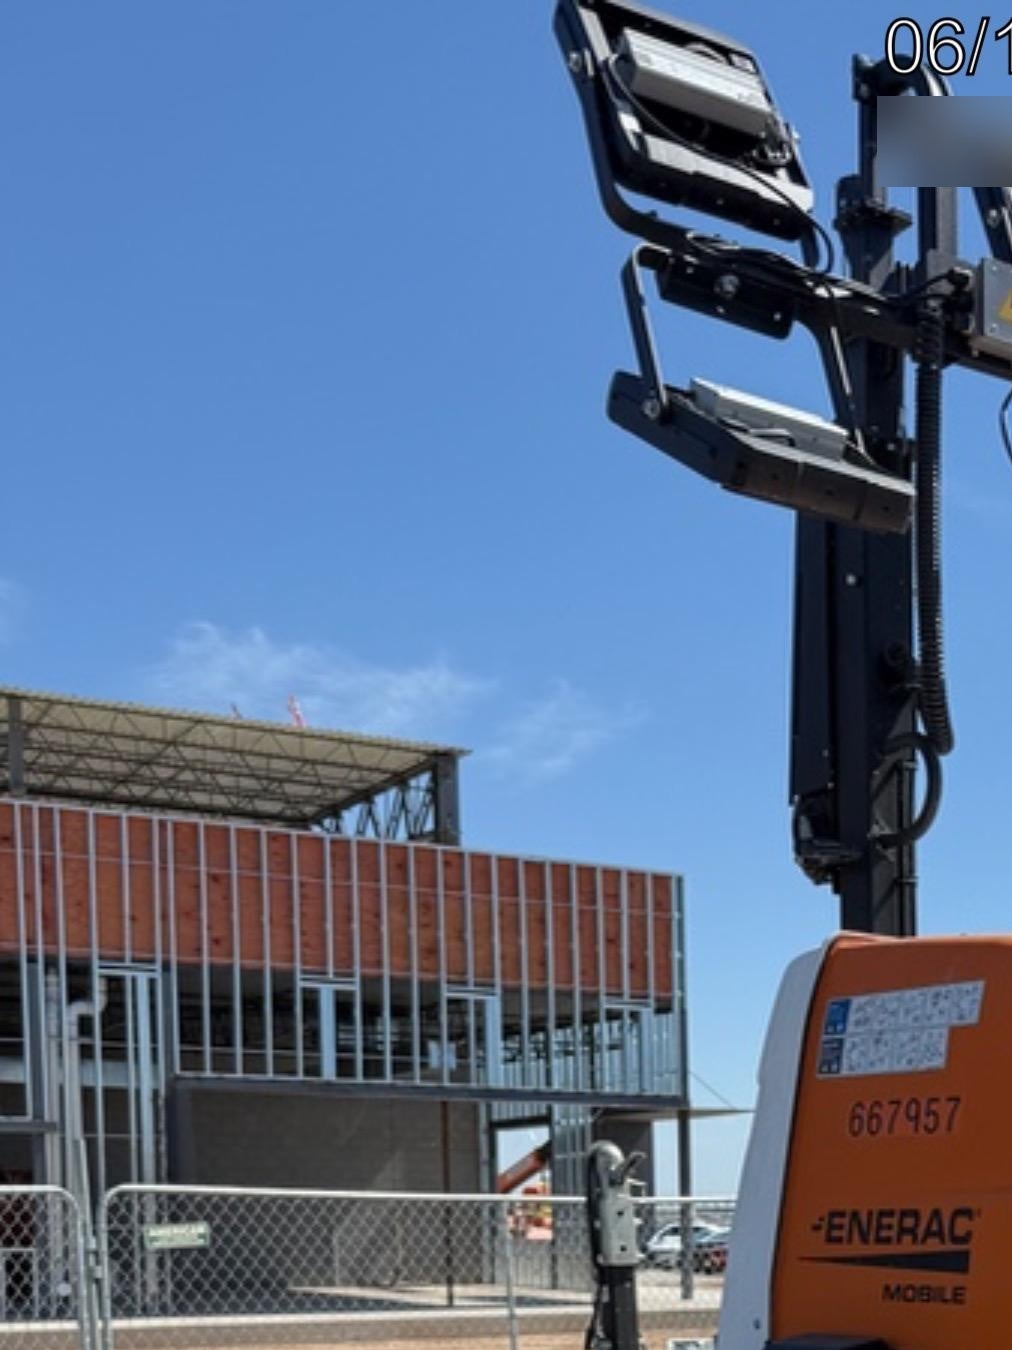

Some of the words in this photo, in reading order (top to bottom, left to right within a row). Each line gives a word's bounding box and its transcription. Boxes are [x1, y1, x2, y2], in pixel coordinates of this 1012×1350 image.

[848, 1096, 961, 1137] 667957
[811, 1207, 974, 1246] ENERAC
[881, 1283, 967, 1305] MOBILE
